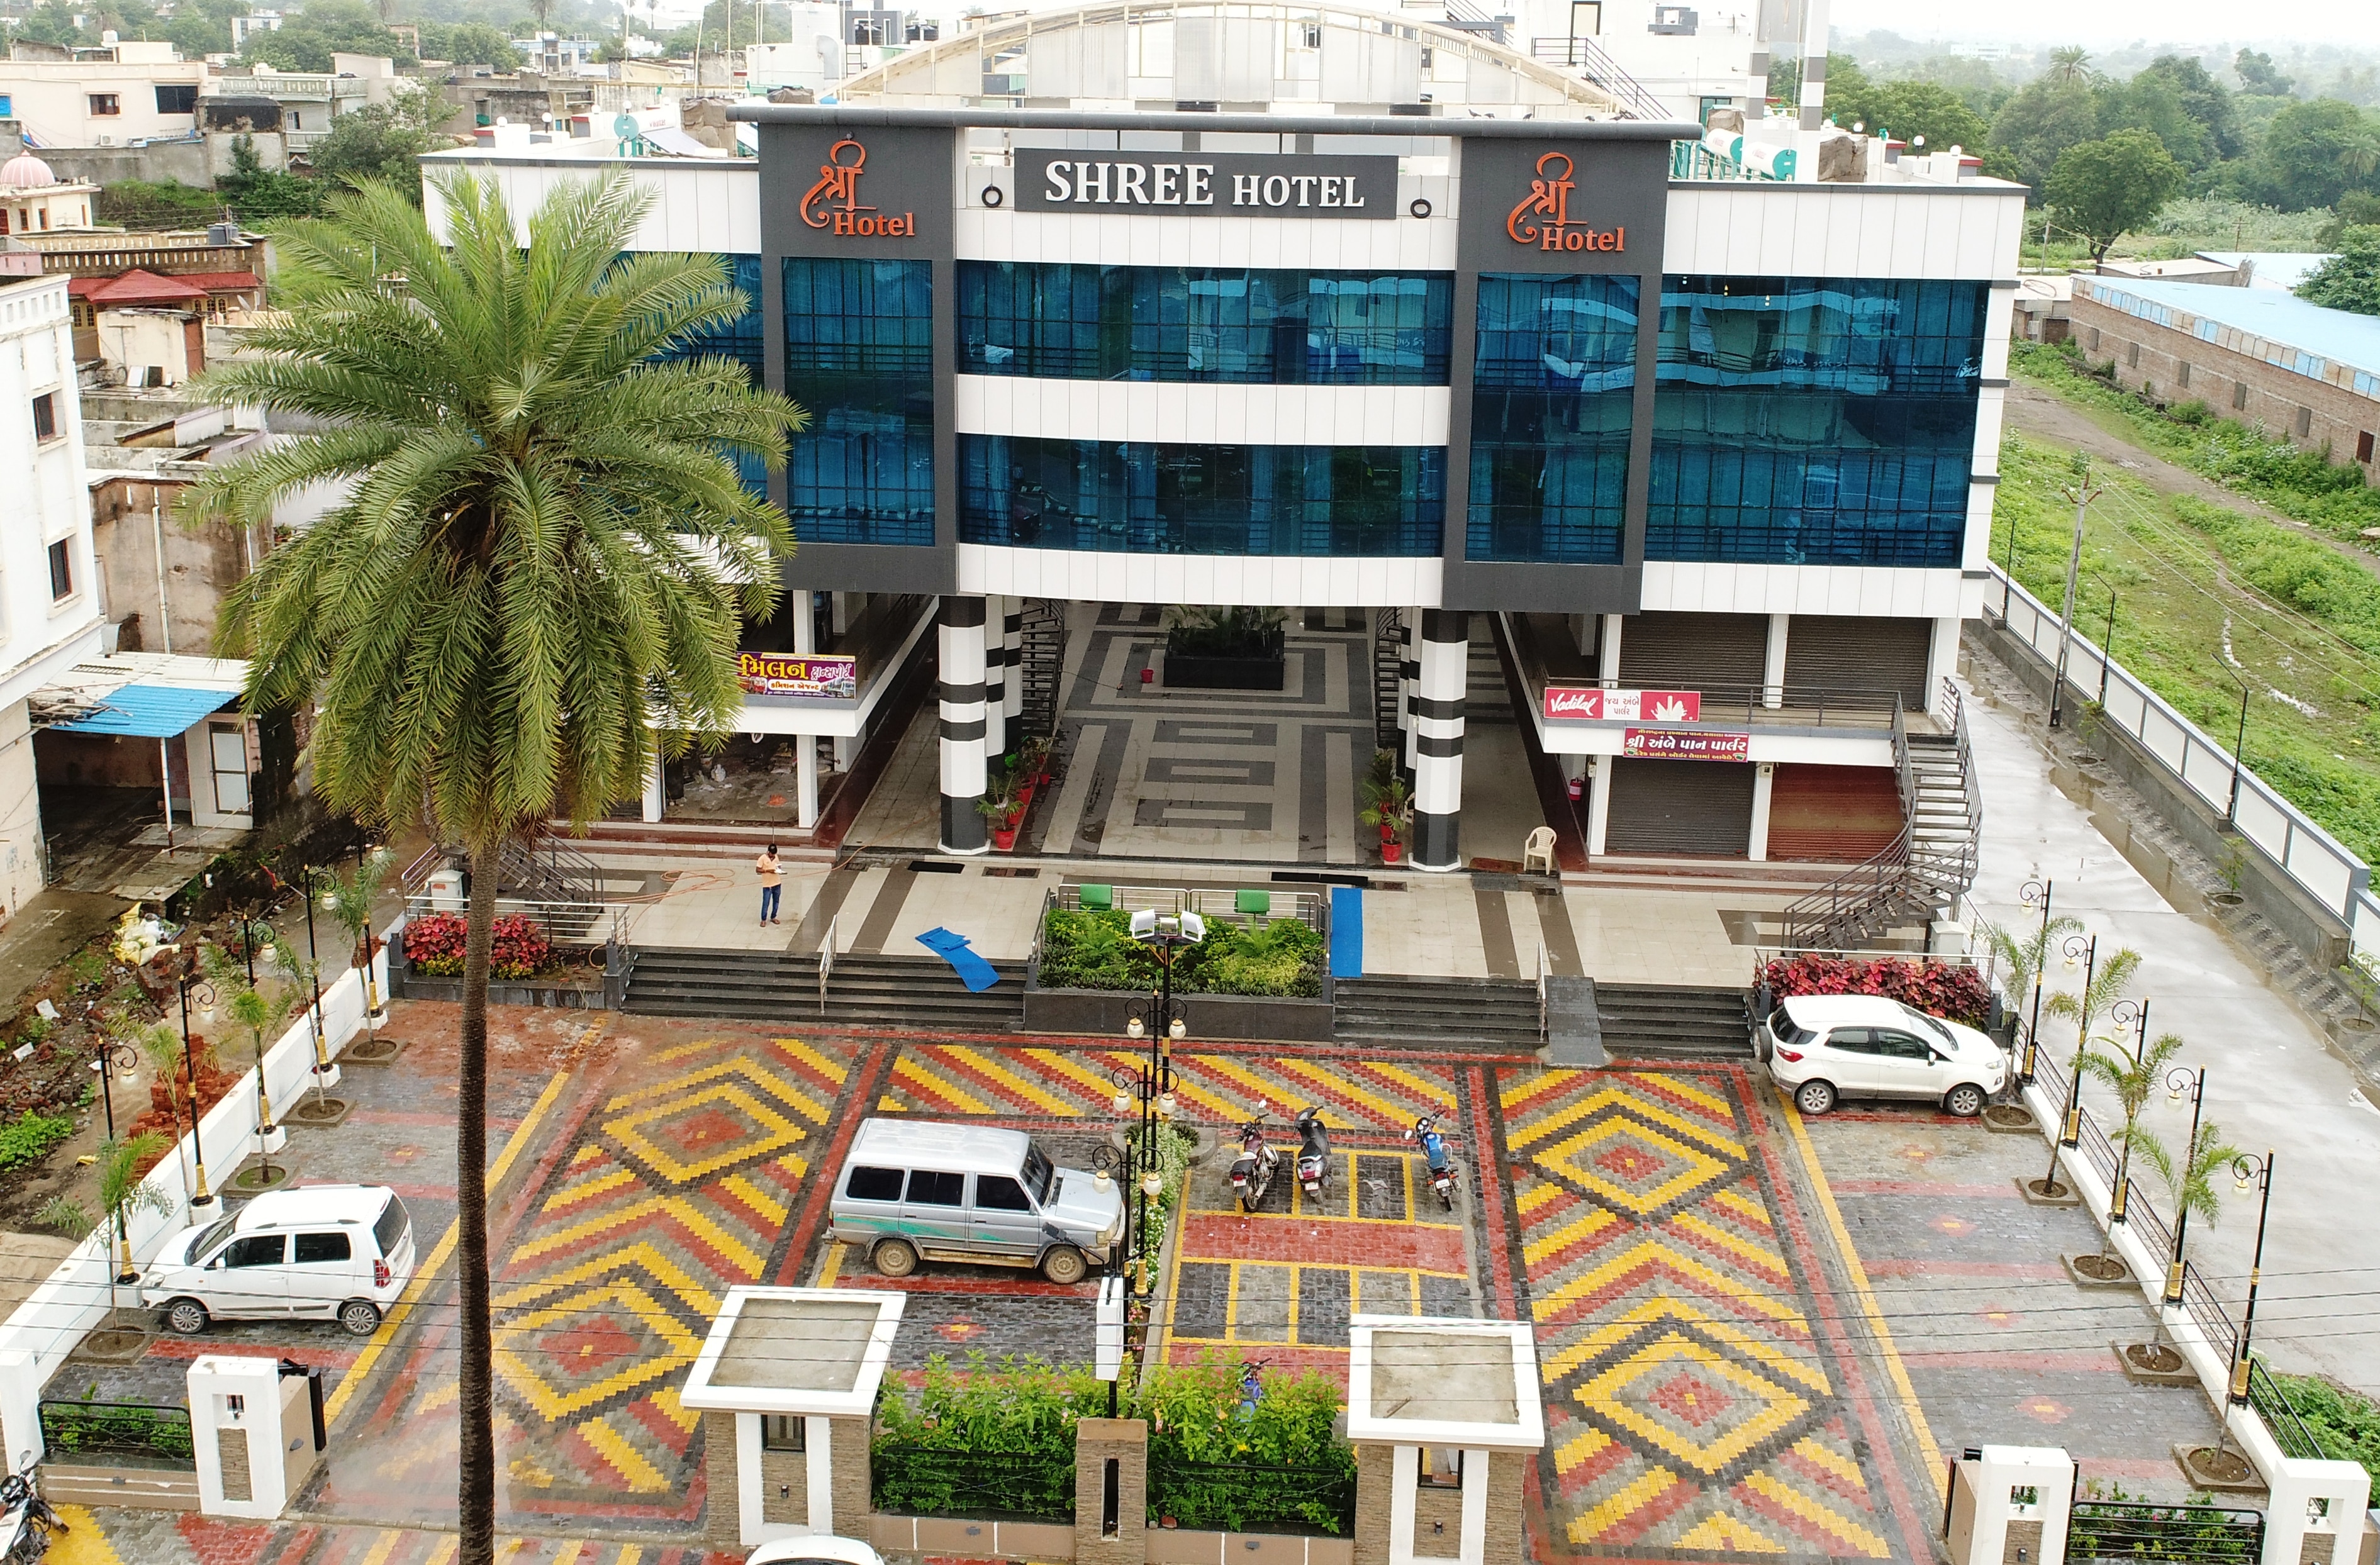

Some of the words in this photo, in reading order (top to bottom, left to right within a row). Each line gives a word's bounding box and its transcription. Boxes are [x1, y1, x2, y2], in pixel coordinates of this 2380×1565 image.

[1045, 160, 1214, 206] SHREE
[1232, 174, 1365, 208] HOTEL
[834, 212, 915, 236] Hotel
[1540, 226, 1625, 252] Hotel
[740, 653, 809, 680] મિલન
[810, 663, 852, 681] ટ્રાન્સપોર્ટ
[771, 681, 795, 689] કમિશન
[797, 682, 820, 690] એજન્ટ
[1550, 693, 1597, 716] Vadilal
[1613, 705, 1630, 715] પાર્લર
[1623, 696, 1640, 706] અંબે
[1626, 734, 1645, 748] શ્રી
[1648, 735, 1676, 749] અંબે
[1680, 740, 1707, 750] પાન
[1711, 738, 1747, 751] પાર્લર
